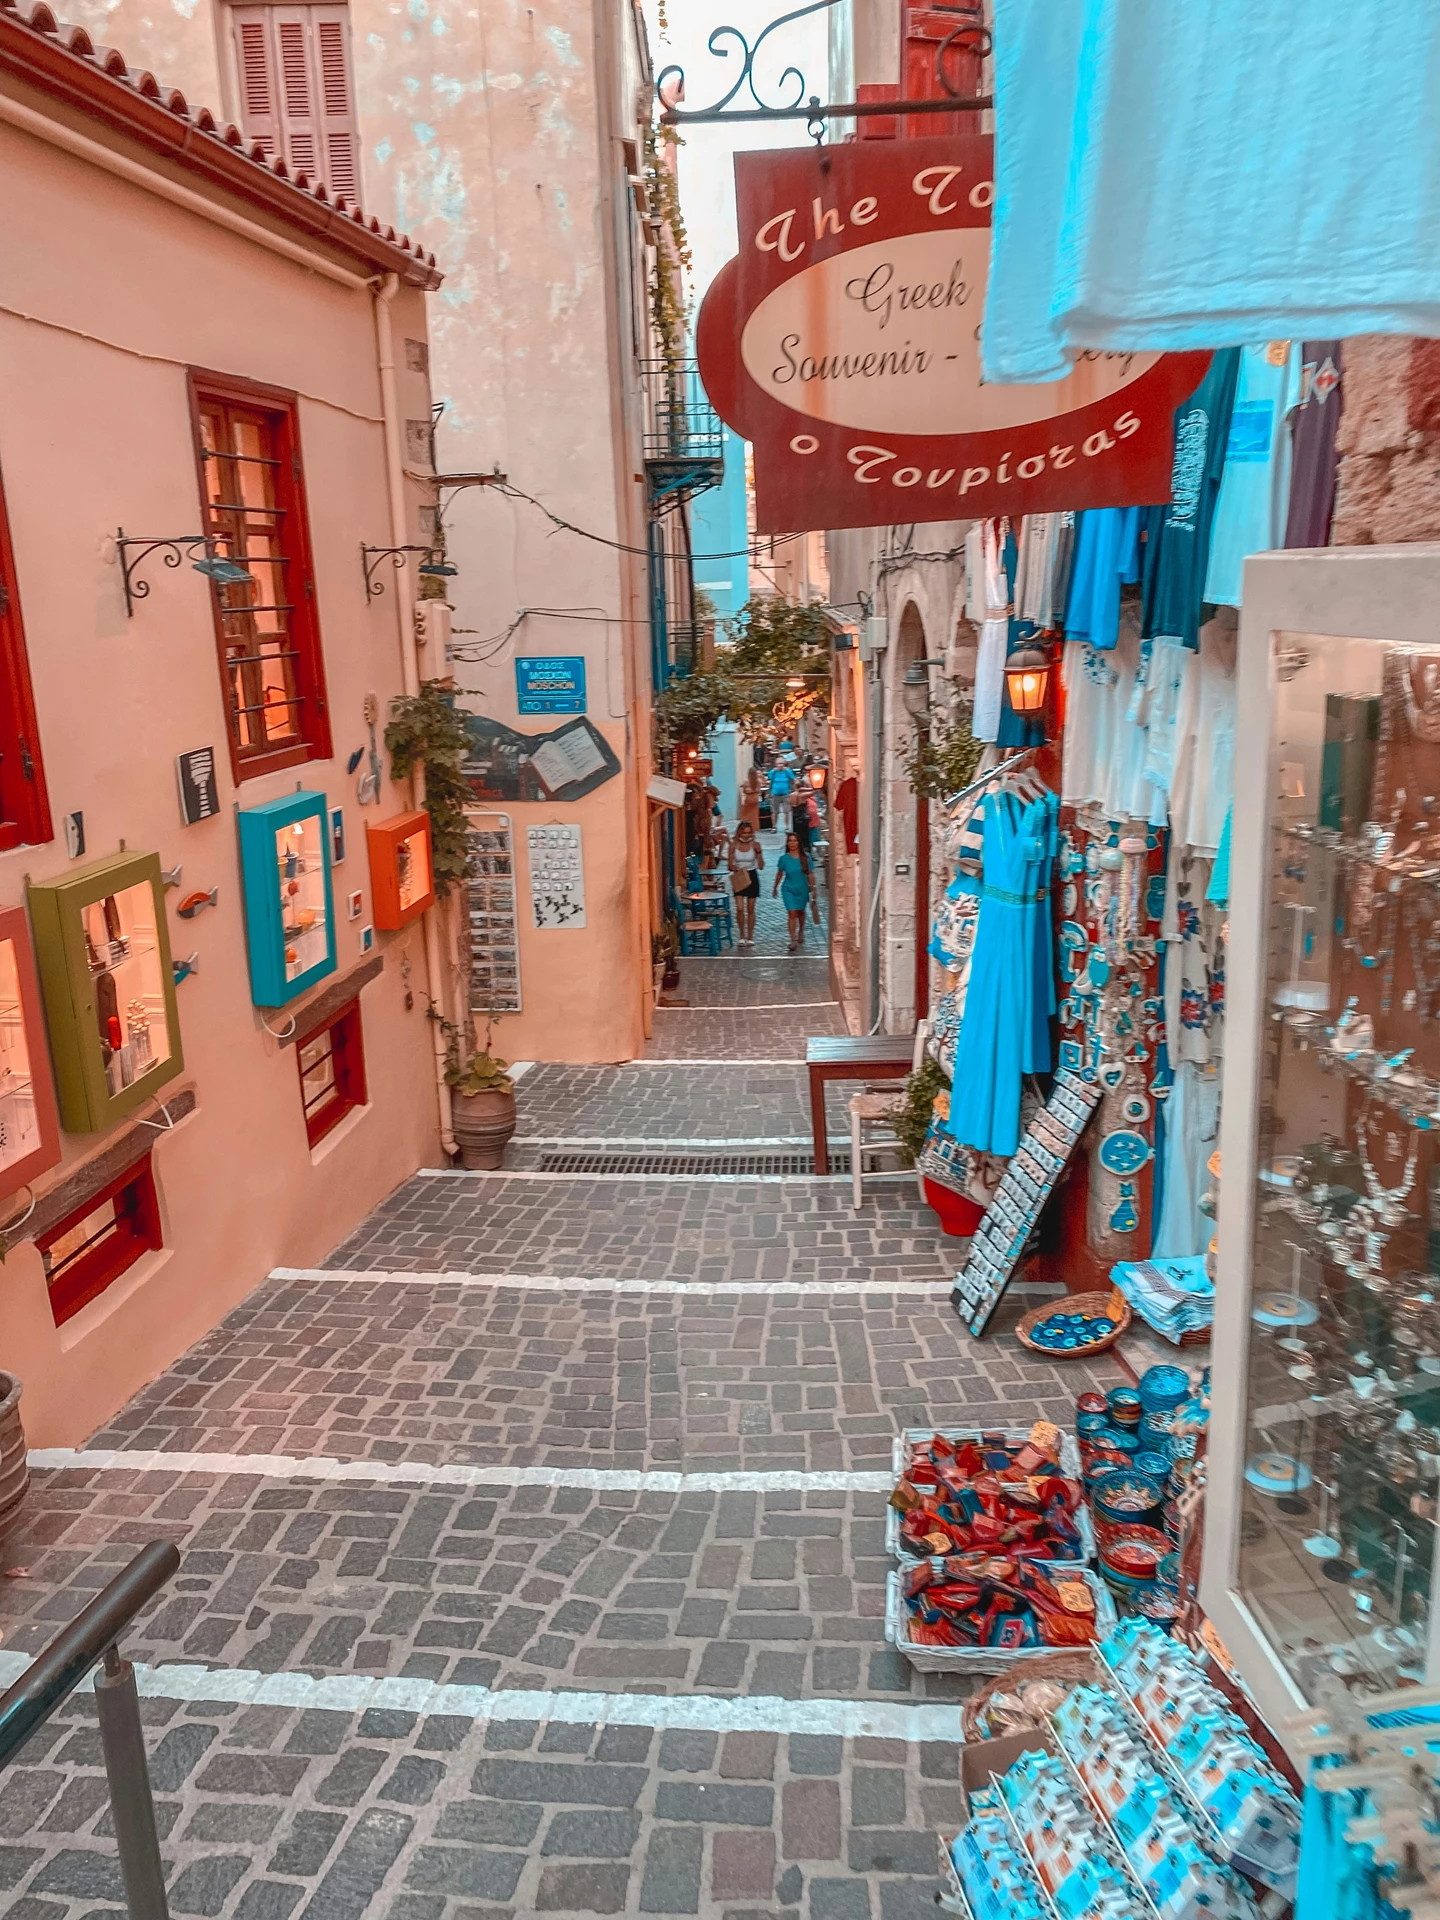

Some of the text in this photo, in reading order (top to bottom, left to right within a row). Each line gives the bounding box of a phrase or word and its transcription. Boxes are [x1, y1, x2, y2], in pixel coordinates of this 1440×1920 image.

[755, 165, 994, 262] The To
[845, 258, 974, 330] Greek
[772, 333, 933, 384] Souvenir
[527, 681, 576, 690] MOSCHON
